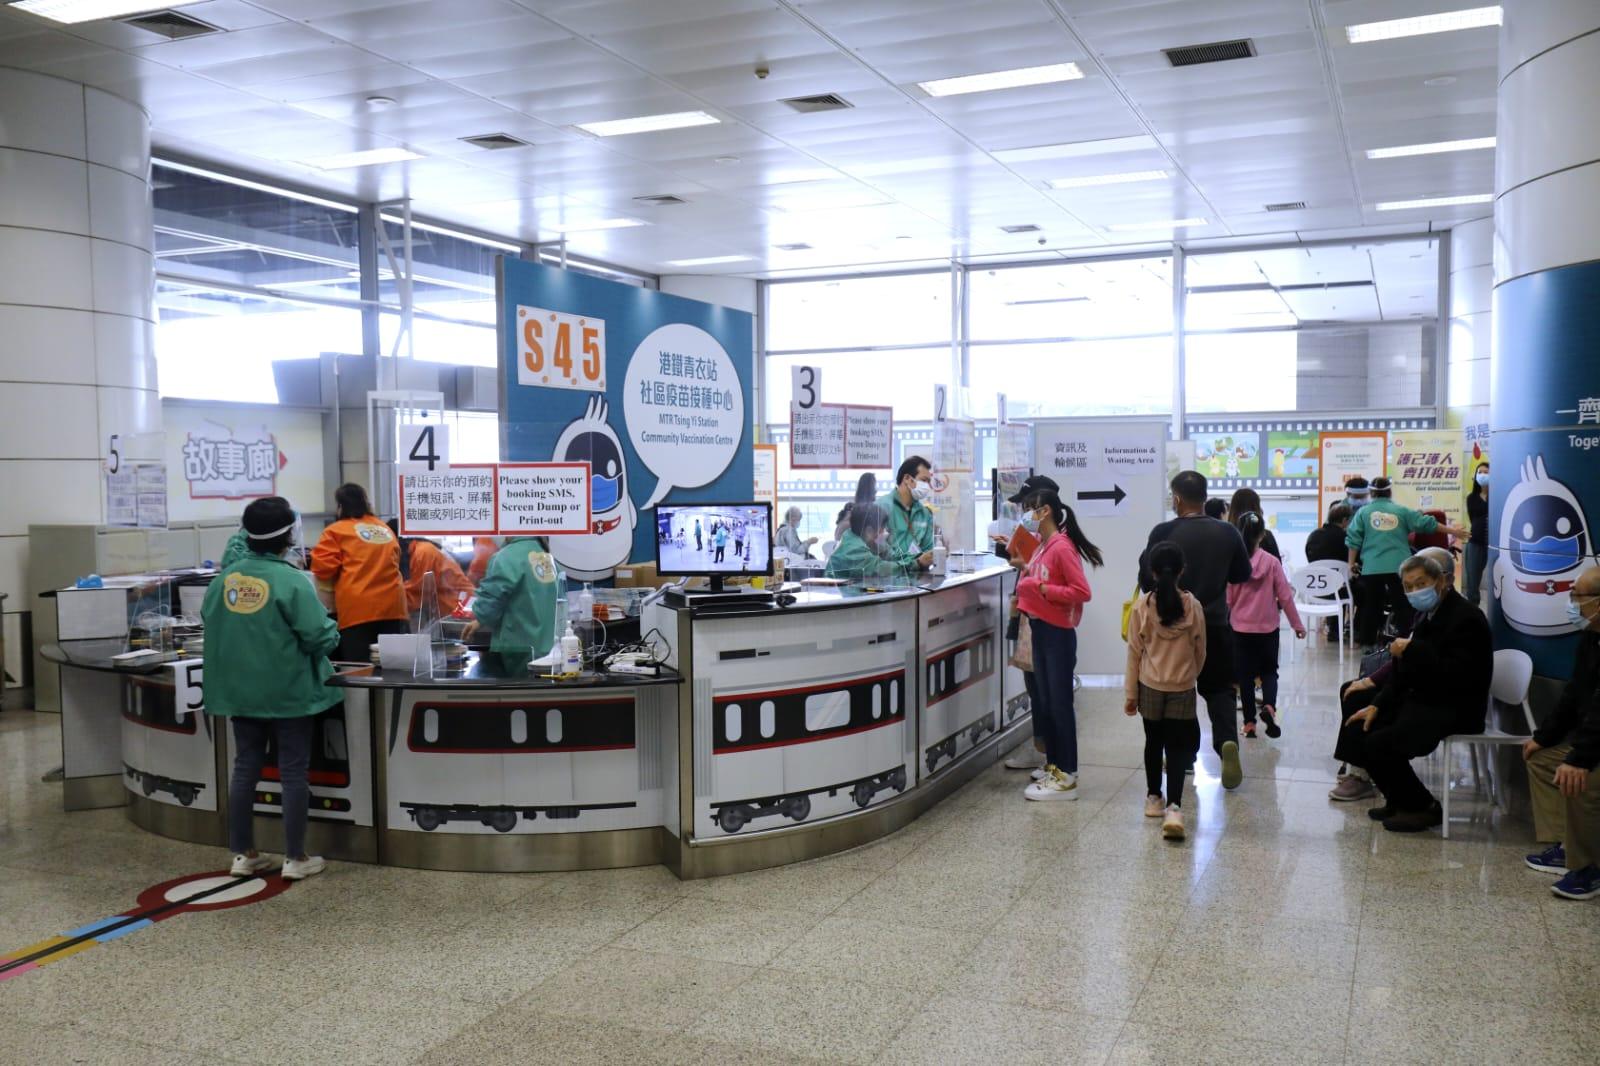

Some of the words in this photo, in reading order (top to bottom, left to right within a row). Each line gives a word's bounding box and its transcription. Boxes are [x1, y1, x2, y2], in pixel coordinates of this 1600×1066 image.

[659, 350, 718, 382] 港鐵青衣站
[640, 379, 733, 411] 社區疫苗接種中心
[799, 366, 815, 409] 3
[938, 386, 945, 422] 2
[659, 413, 674, 425] MTR
[674, 414, 690, 429] Tsing
[690, 415, 697, 427] Yi
[698, 416, 719, 428] Station
[641, 430, 680, 445] Community
[679, 432, 715, 444] Vaccination
[715, 435, 733, 445] Centre
[1568, 435, 1600, 450] Toge
[110, 434, 119, 474] 5
[409, 425, 441, 471] 4
[1055, 442, 1087, 454] 資訊及
[184, 439, 277, 481] 故事廊
[1054, 456, 1087, 469] 輪候區
[1107, 457, 1135, 465] Waiting
[404, 475, 492, 489] 請出示你的預約
[500, 475, 529, 485] Please
[532, 475, 557, 485] show
[560, 477, 583, 488] your
[405, 491, 493, 505] 手機短訊、屏幕
[506, 489, 546, 500] booking
[549, 489, 575, 499] SMS,
[406, 507, 491, 521] 截圖或列印文件
[502, 502, 534, 511] Screen
[537, 502, 567, 513] Dump
[569, 503, 581, 511] or
[519, 515, 563, 525] Print-out
[1306, 574, 1328, 589] 25
[186, 664, 203, 709] 5
